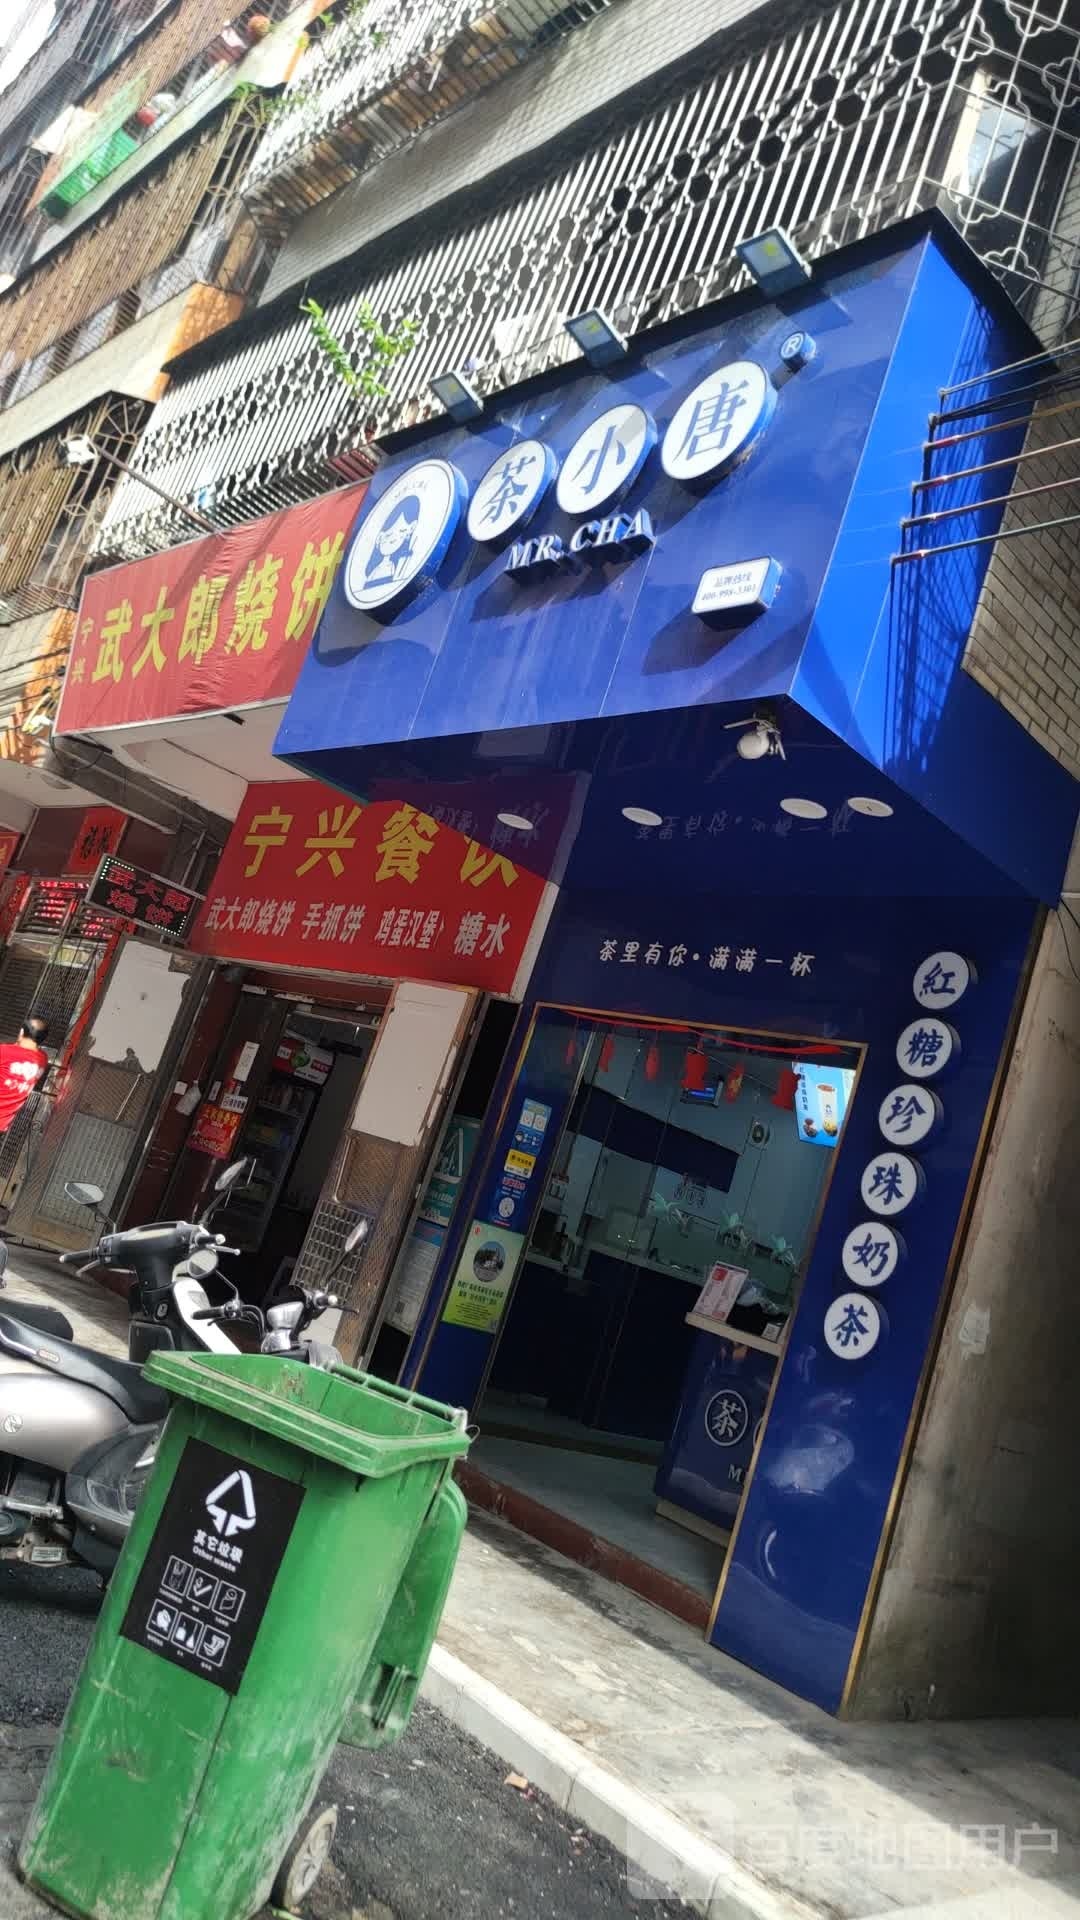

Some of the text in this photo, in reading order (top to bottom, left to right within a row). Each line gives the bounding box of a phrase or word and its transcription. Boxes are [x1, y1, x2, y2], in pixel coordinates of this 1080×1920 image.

[479, 379, 748, 524] 茶小唐
[570, 510, 648, 552] CHA
[91, 531, 345, 683] 武大郎烧饼
[203, 895, 297, 938] 武大郎烧饼
[301, 903, 367, 944] 手抓饼
[453, 910, 511, 958] 糖水
[831, 961, 958, 1349] 紅糖珍珠奶茶
[711, 1399, 741, 1438] 茶
[193, 1528, 244, 1564] 其它垃圾
